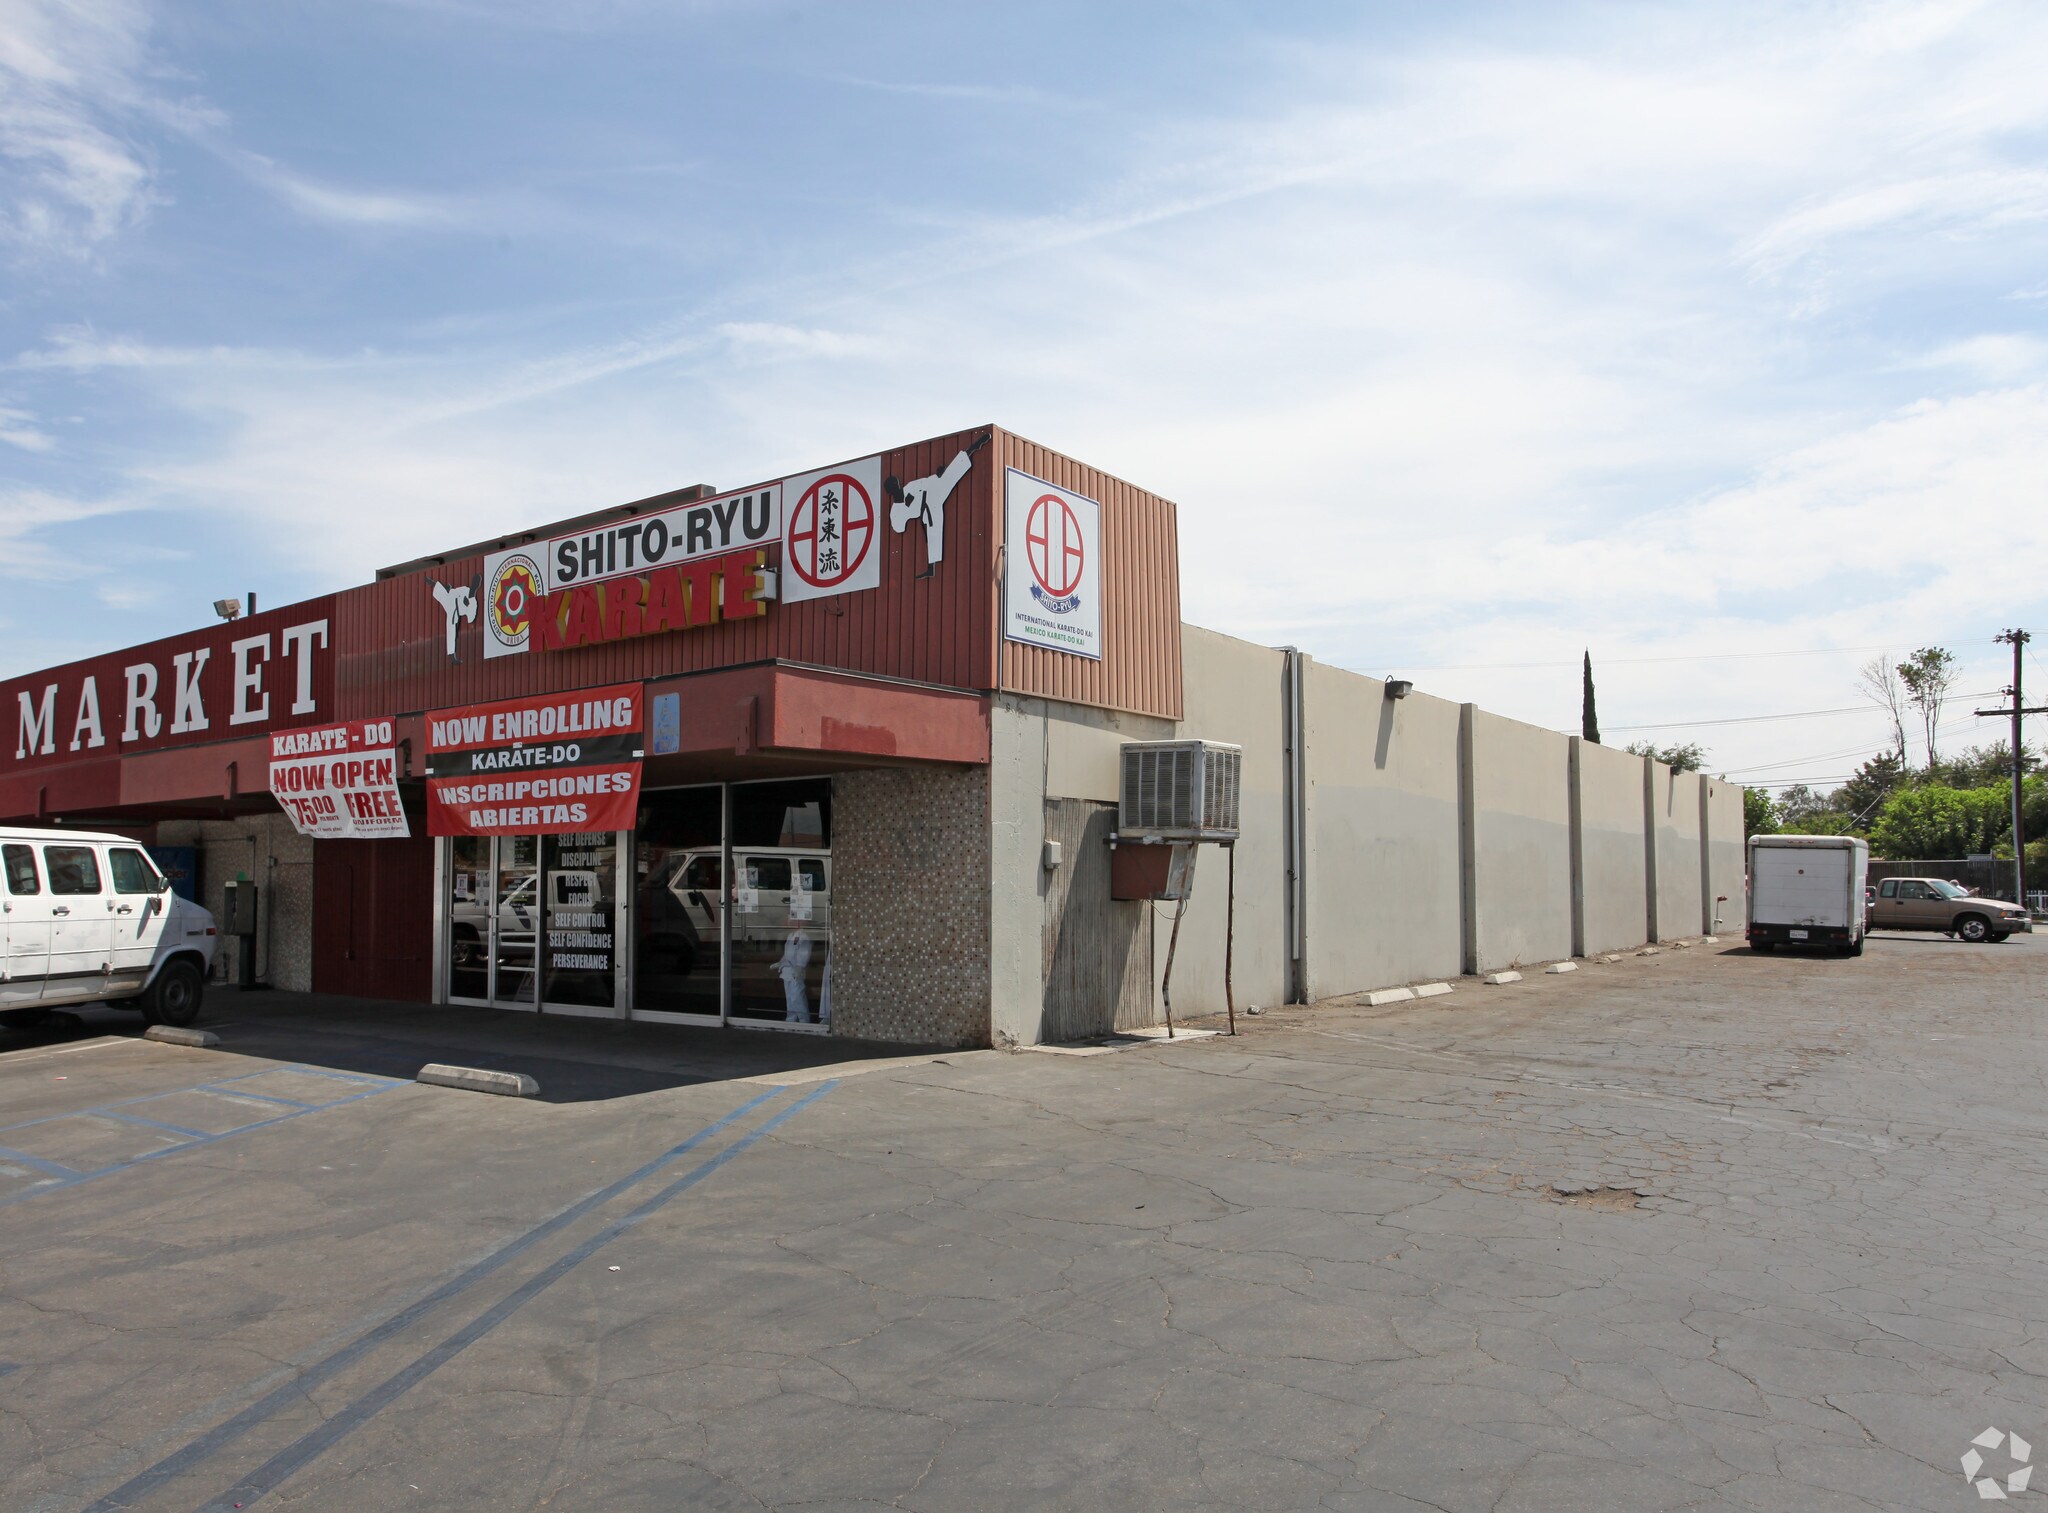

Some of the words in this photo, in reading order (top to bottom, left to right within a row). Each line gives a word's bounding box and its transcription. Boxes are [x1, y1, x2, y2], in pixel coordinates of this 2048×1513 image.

[557, 491, 771, 582] SHITO-RYU
[533, 573, 542, 596] KARA
[528, 550, 767, 653] KARATE
[1015, 612, 1056, 630] INTERNATIONAL
[1057, 622, 1084, 636] KARATE-DO
[1085, 630, 1093, 638] KAI
[1025, 625, 1046, 637] MEXICO
[1047, 630, 1076, 643] KARATE-DO
[1076, 637, 1085, 646] KAI
[15, 618, 328, 760] MARKET
[432, 715, 487, 747] NOW
[492, 697, 632, 741] ENROLLING
[273, 728, 347, 757] KARATE
[364, 722, 392, 746] DO
[472, 743, 581, 770] KARATE-DO
[273, 764, 326, 794] NOW
[331, 758, 393, 790] OPEN
[437, 772, 631, 805] INSCRIPCIONES
[343, 790, 402, 819] FREE
[470, 803, 588, 828] ABIERTAS
[353, 817, 403, 825] UNIFORM
[558, 833, 574, 847] SELF
[575, 831, 606, 846] DEFENSE
[561, 852, 602, 867] DISCIPLINE
[565, 874, 597, 887] RESPECT
[568, 892, 593, 907] FOCUS
[555, 912, 571, 927] SELF
[573, 913, 606, 928] CONTROL
[549, 932, 566, 947] SELF
[566, 932, 612, 949] CONFIDENCE
[553, 953, 608, 970] PERSEVERANCE
